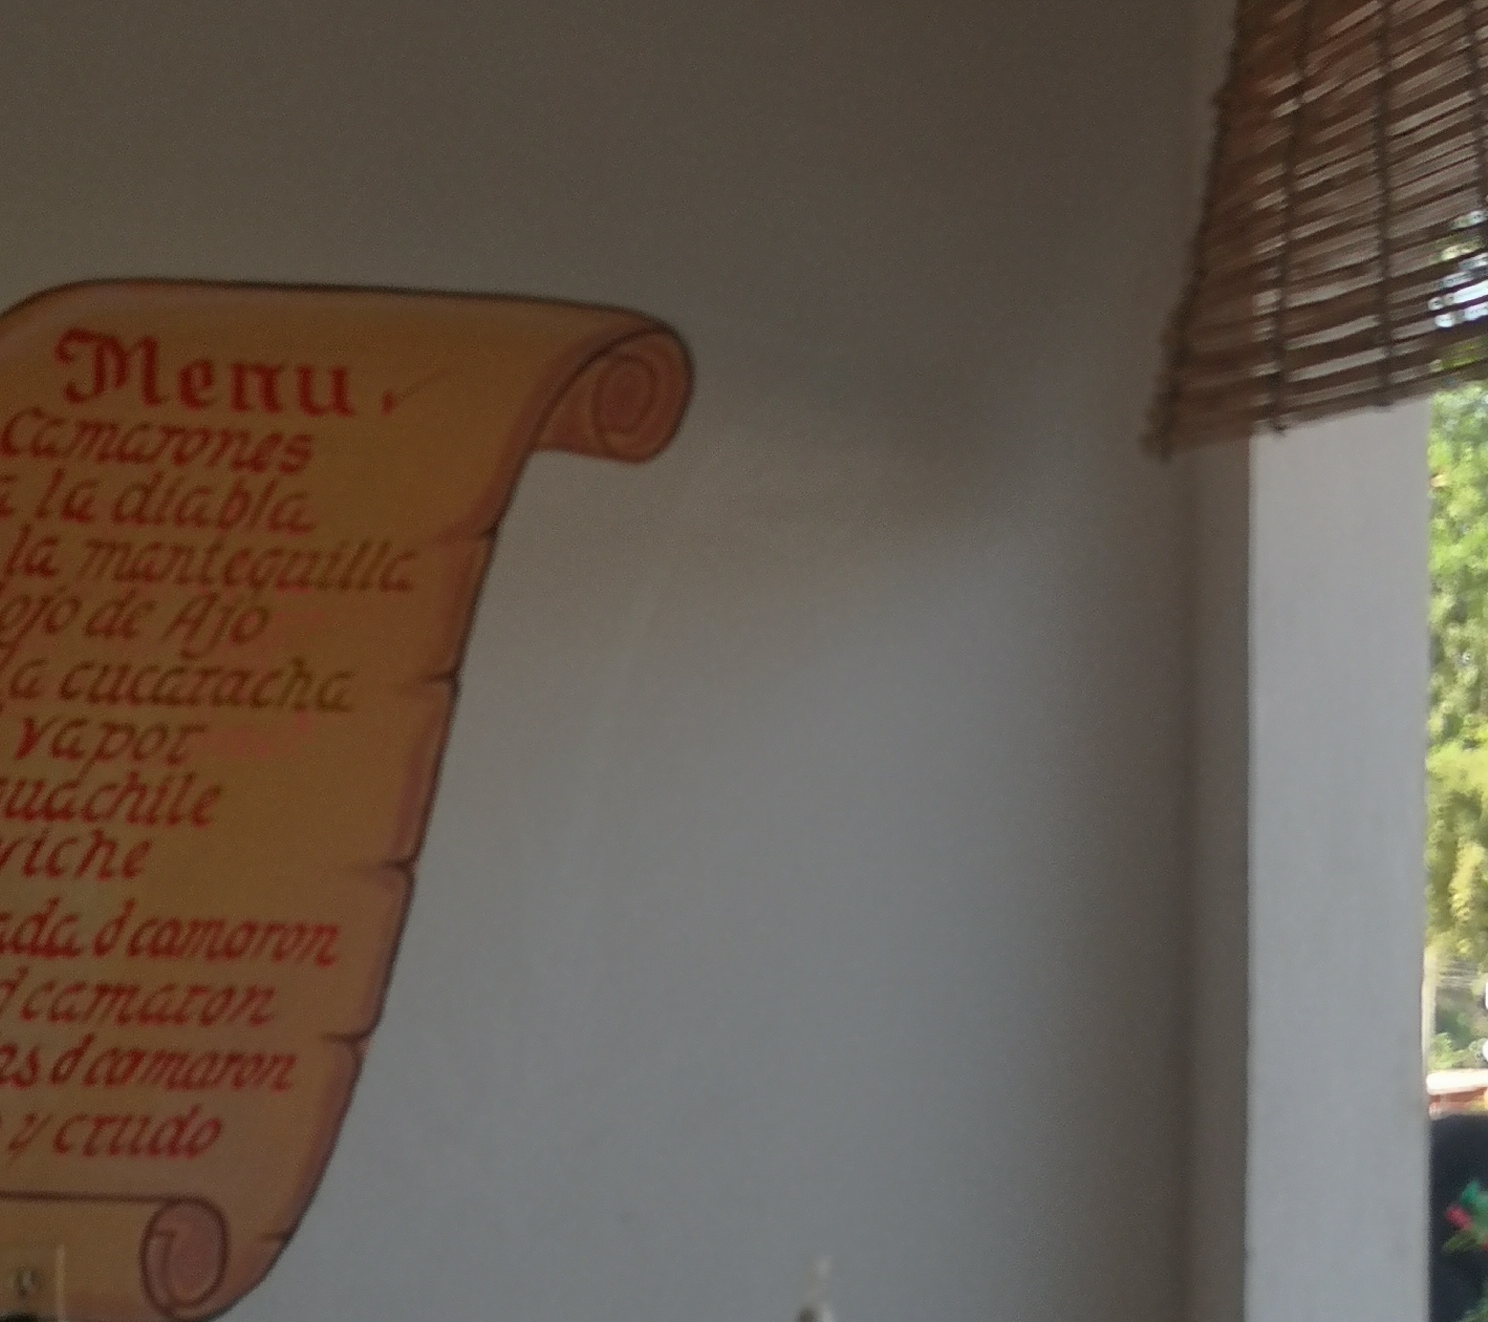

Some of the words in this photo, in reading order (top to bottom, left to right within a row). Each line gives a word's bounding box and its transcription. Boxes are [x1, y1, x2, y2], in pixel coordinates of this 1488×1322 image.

[53, 325, 356, 419] Menu
[34, 467, 98, 523] la
[109, 470, 318, 534] diabla
[2, 522, 60, 579] la
[82, 589, 158, 640] de
[57, 656, 356, 713] cucaracha
[0, 771, 224, 828] uachile
[52, 1103, 224, 1159] crudo
